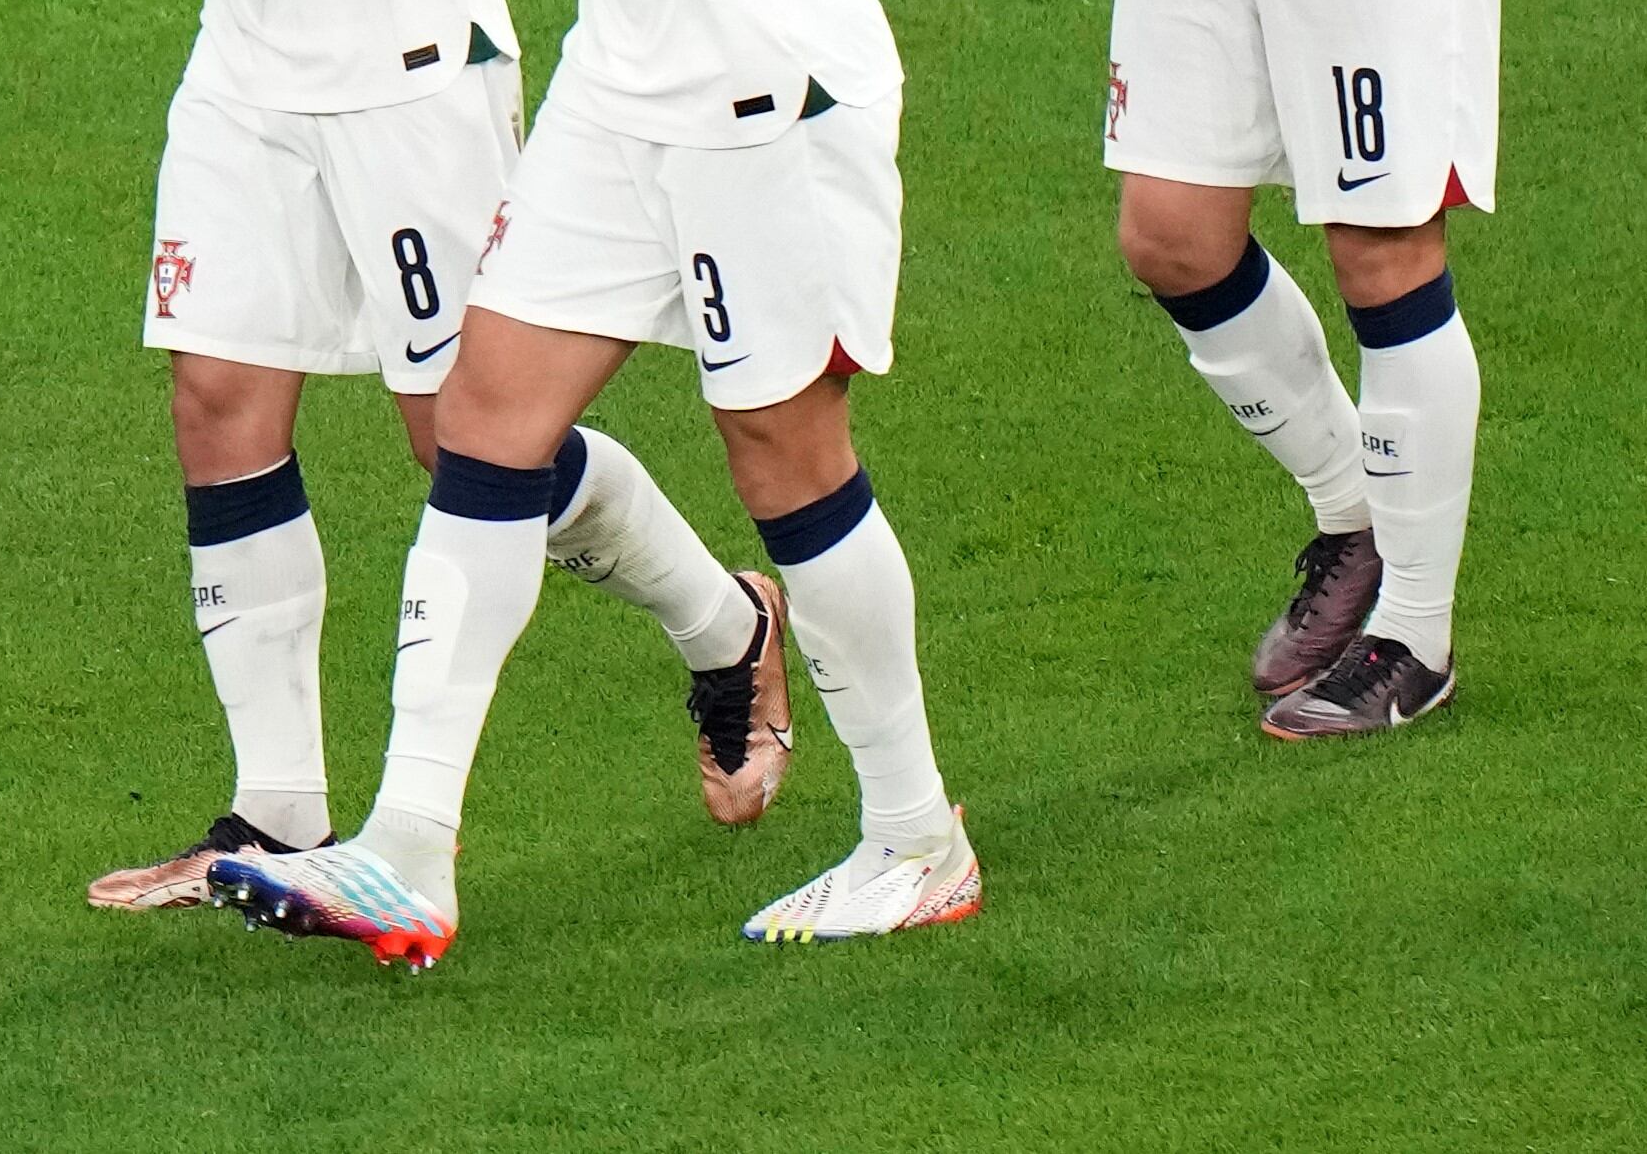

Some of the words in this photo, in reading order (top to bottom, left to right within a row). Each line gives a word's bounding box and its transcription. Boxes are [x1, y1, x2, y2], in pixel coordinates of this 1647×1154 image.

[1331, 65, 1385, 162] 18
[392, 228, 440, 321] 8
[693, 252, 732, 343] 3
